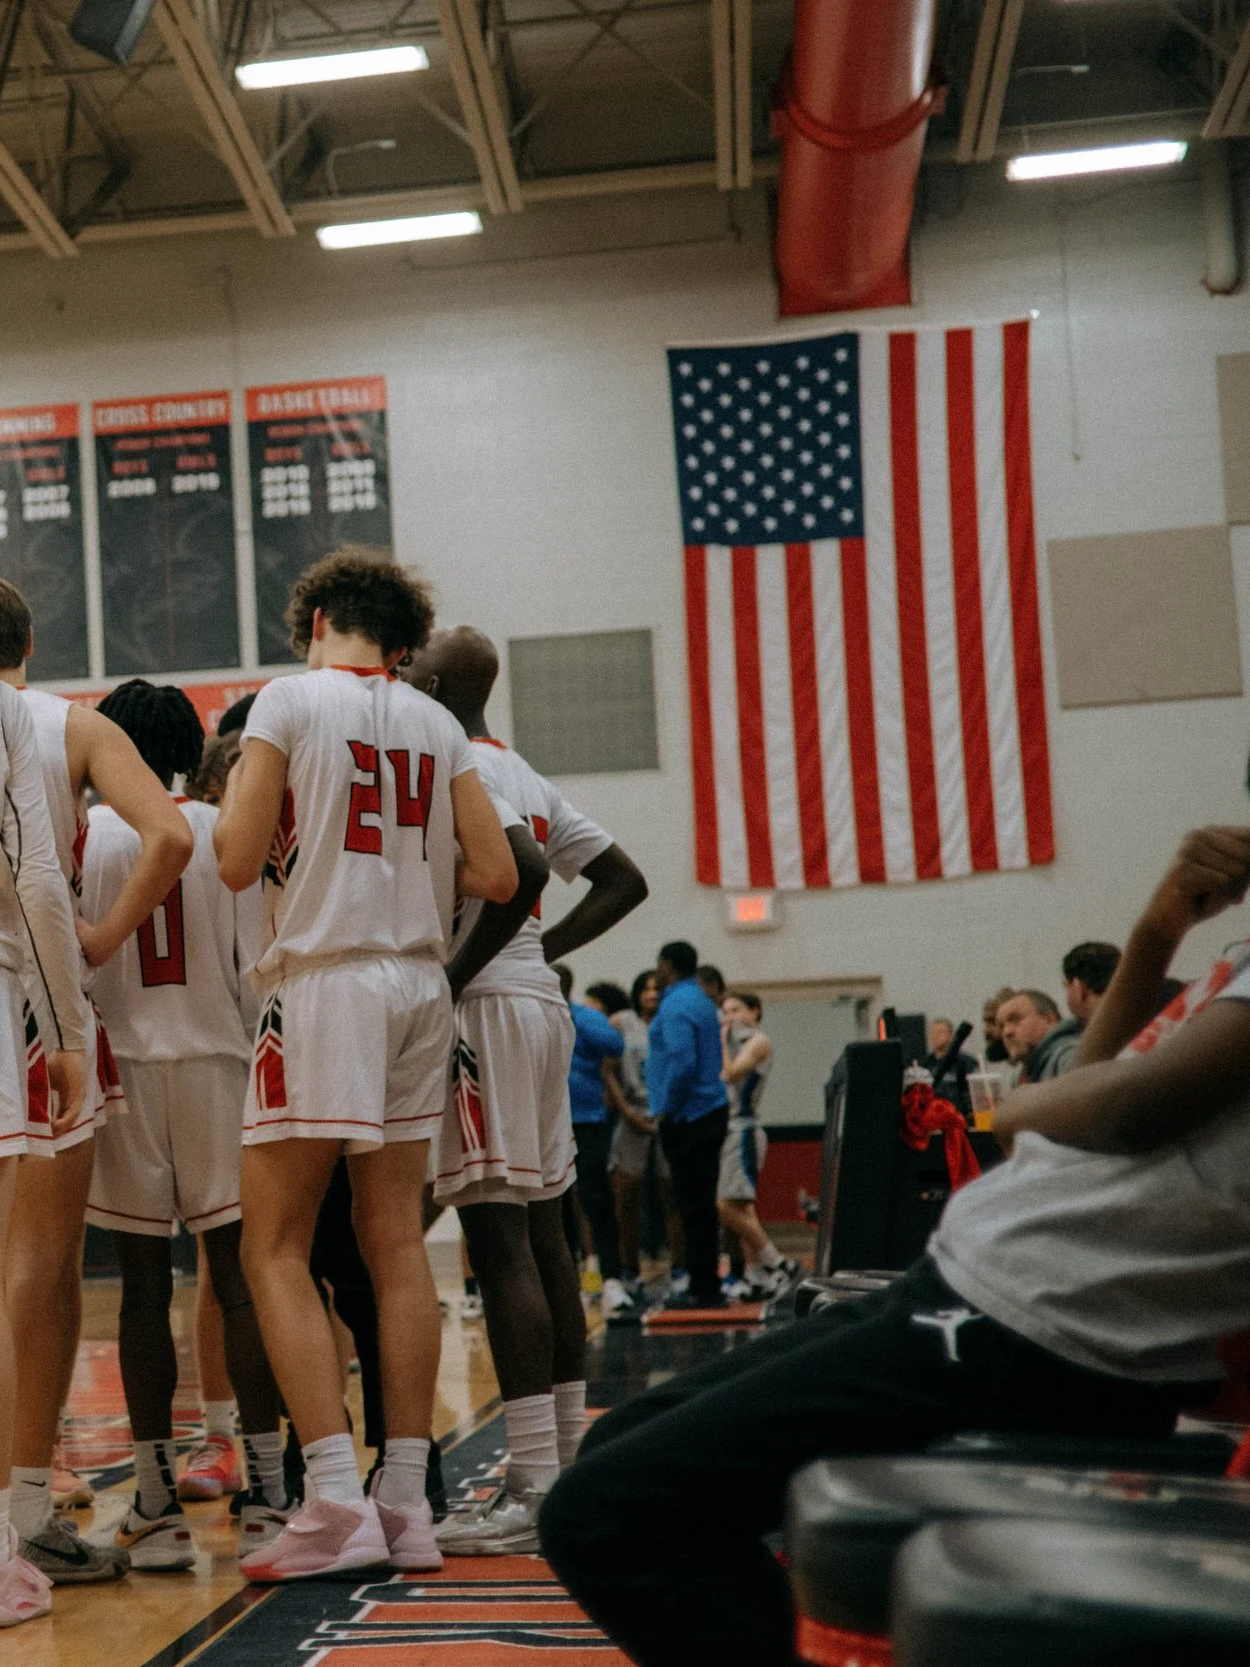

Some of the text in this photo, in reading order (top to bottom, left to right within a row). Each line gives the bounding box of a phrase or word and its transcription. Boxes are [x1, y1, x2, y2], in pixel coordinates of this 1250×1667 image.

[96, 399, 226, 427] CROSS COUNTRY
[257, 388, 370, 414] BASKETBALL
[344, 740, 434, 861] 24
